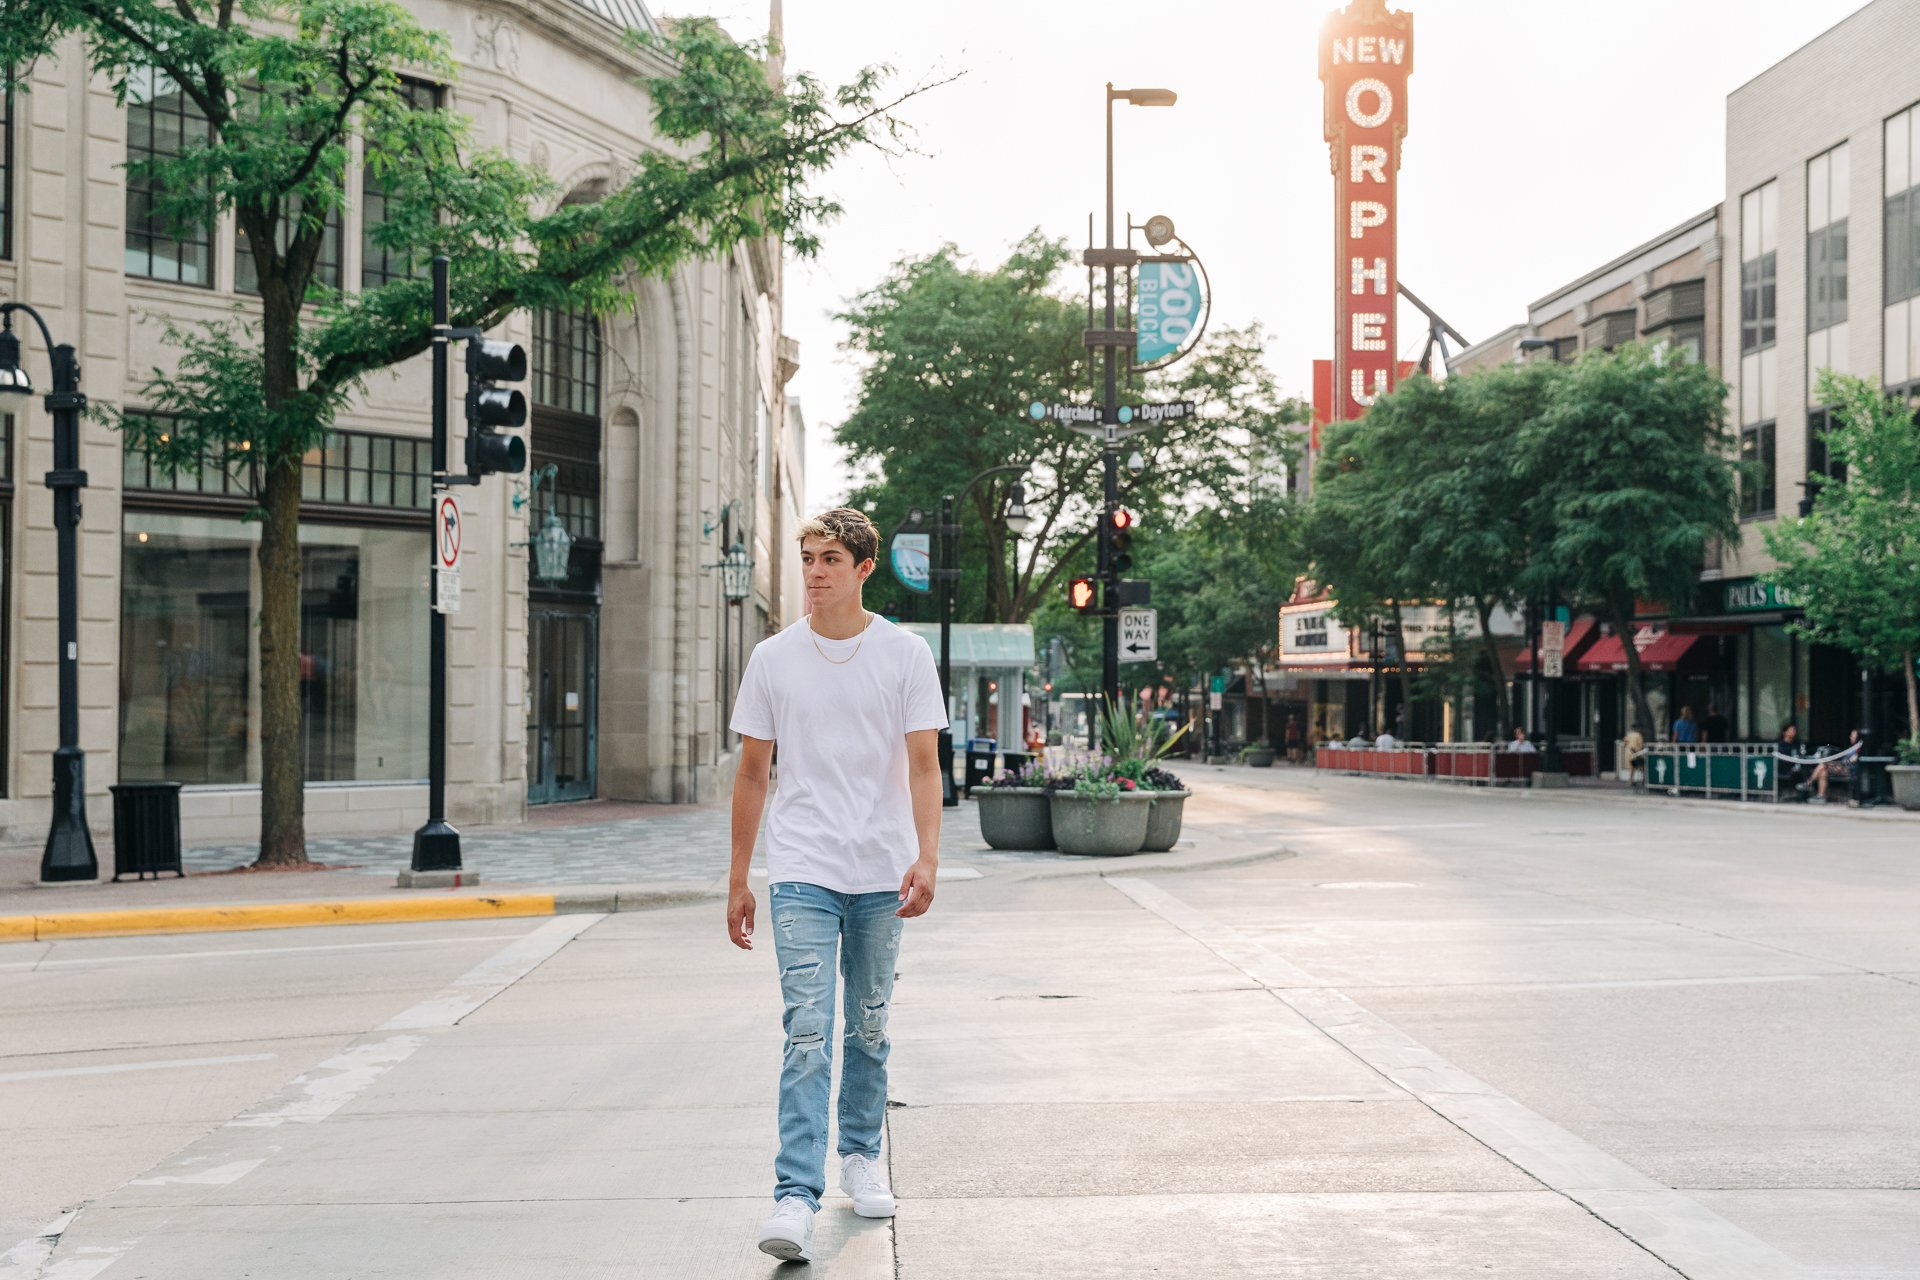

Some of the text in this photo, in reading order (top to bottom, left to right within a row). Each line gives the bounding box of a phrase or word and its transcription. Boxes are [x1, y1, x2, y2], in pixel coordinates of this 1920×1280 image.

[1333, 36, 1405, 64] NEW
[1345, 77, 1393, 407] ORPHEU
[1139, 278, 1159, 345] BLOCK
[1159, 262, 1194, 345] 200
[1053, 403, 1095, 421] Fairchild
[1141, 403, 1184, 421] Dayton
[1728, 583, 1768, 608] PAUL'S
[1124, 615, 1150, 627] ONE
[1124, 629, 1151, 640] WAY
